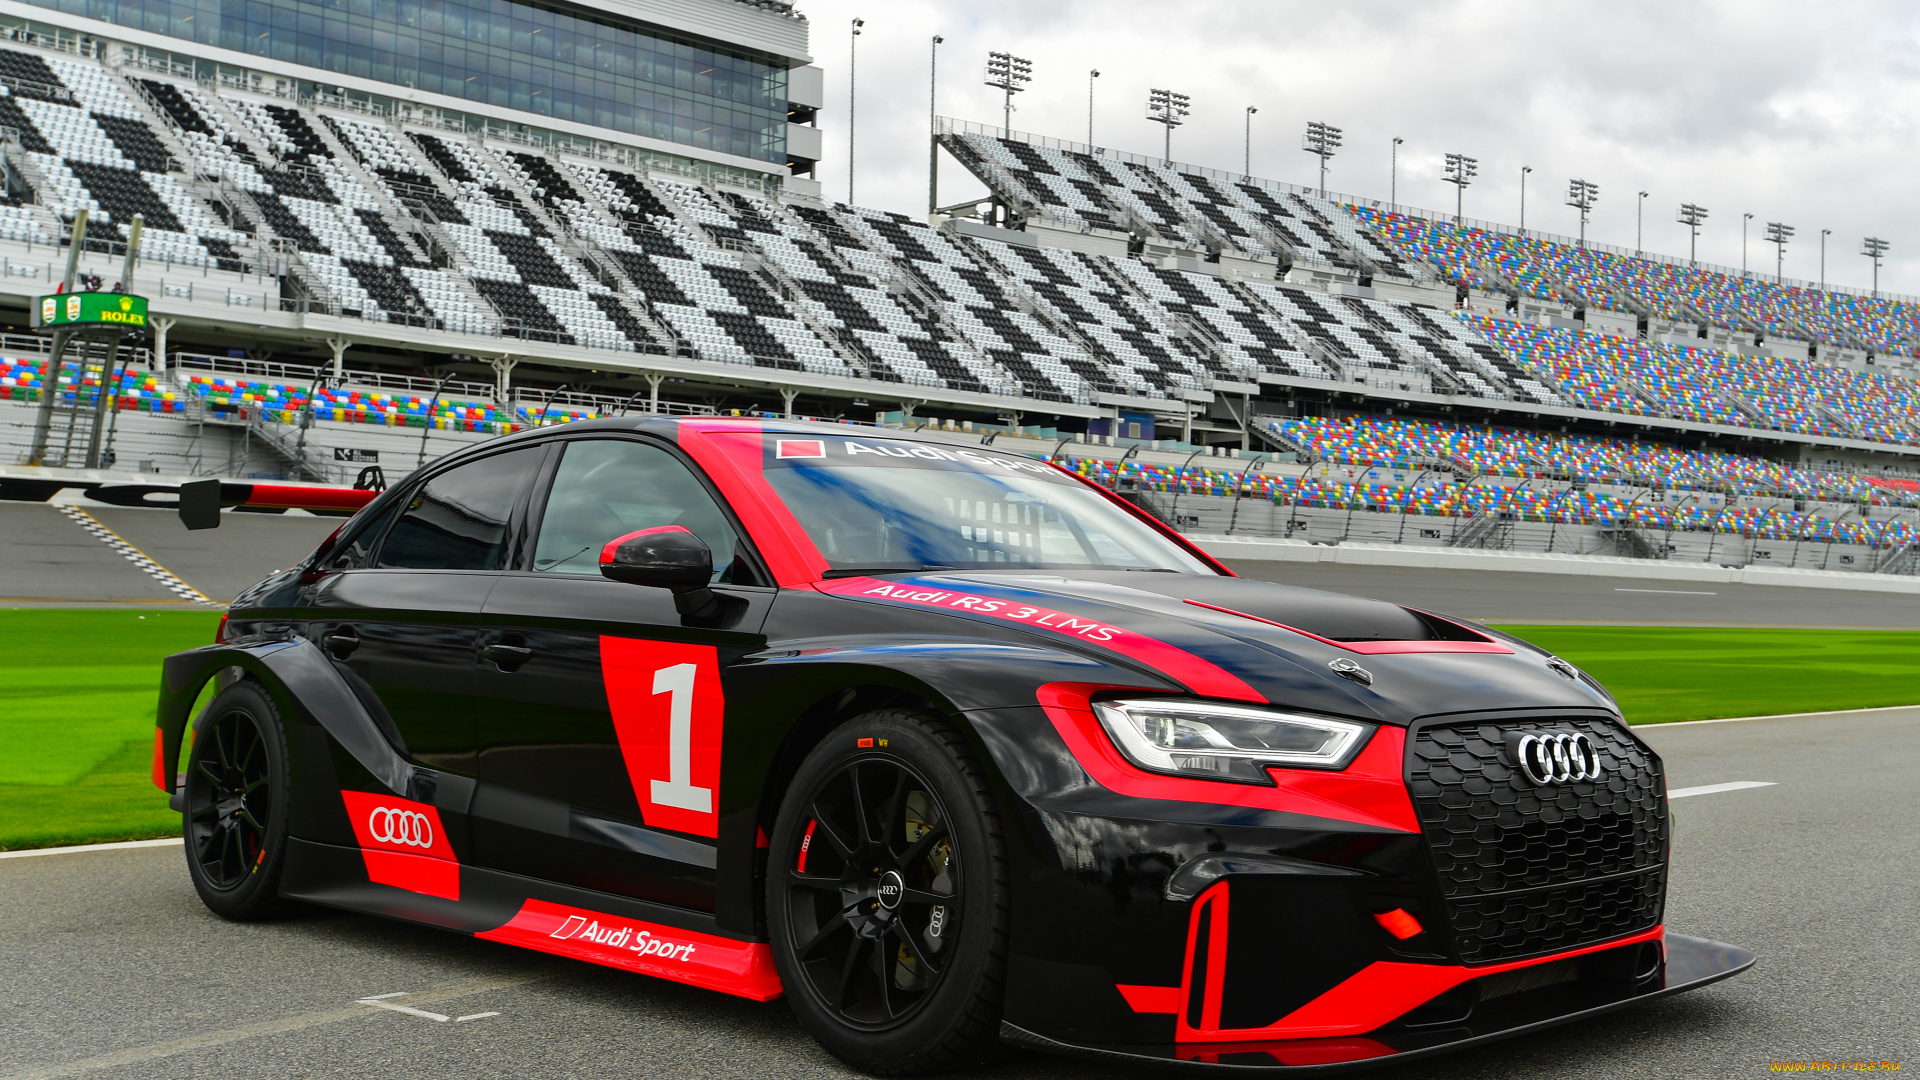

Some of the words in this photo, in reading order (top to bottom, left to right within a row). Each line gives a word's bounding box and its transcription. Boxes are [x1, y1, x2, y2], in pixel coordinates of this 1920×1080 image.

[102, 311, 143, 324] ROLEX
[325, 377, 339, 389] 145
[601, 404, 613, 415] 144
[844, 441, 958, 461] Audi
[957, 450, 1075, 481] Sport
[863, 585, 951, 603] Audi
[950, 596, 1007, 612] RS
[1006, 607, 1038, 619] 3
[1036, 613, 1122, 641] LMS
[651, 663, 712, 813] 1
[578, 920, 633, 947] Audi
[629, 930, 696, 961] Sport
